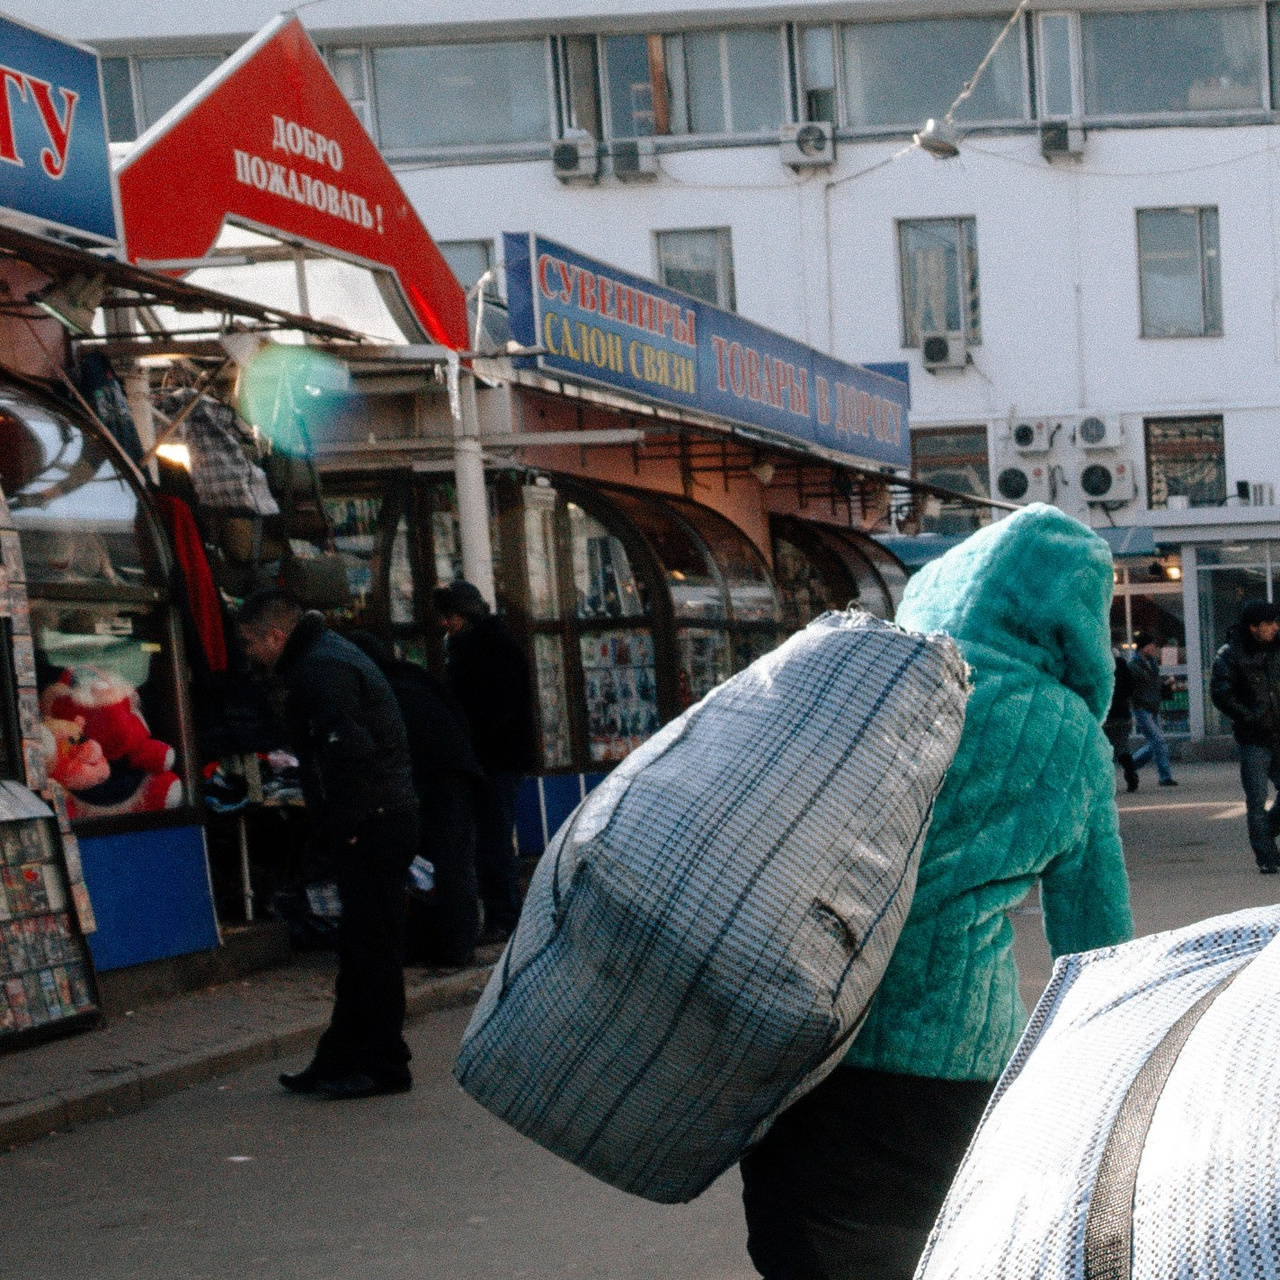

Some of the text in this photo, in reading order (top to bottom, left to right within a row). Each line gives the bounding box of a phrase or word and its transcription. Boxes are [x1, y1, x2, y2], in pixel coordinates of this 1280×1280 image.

[272, 115, 343, 172] ДОБРО
[537, 254, 696, 348] СУВЕНИРЫ
[543, 312, 695, 394] САЛОН СВЯЗИ
[711, 335, 902, 447] ТОВАРЫ В ДОРОГУ
